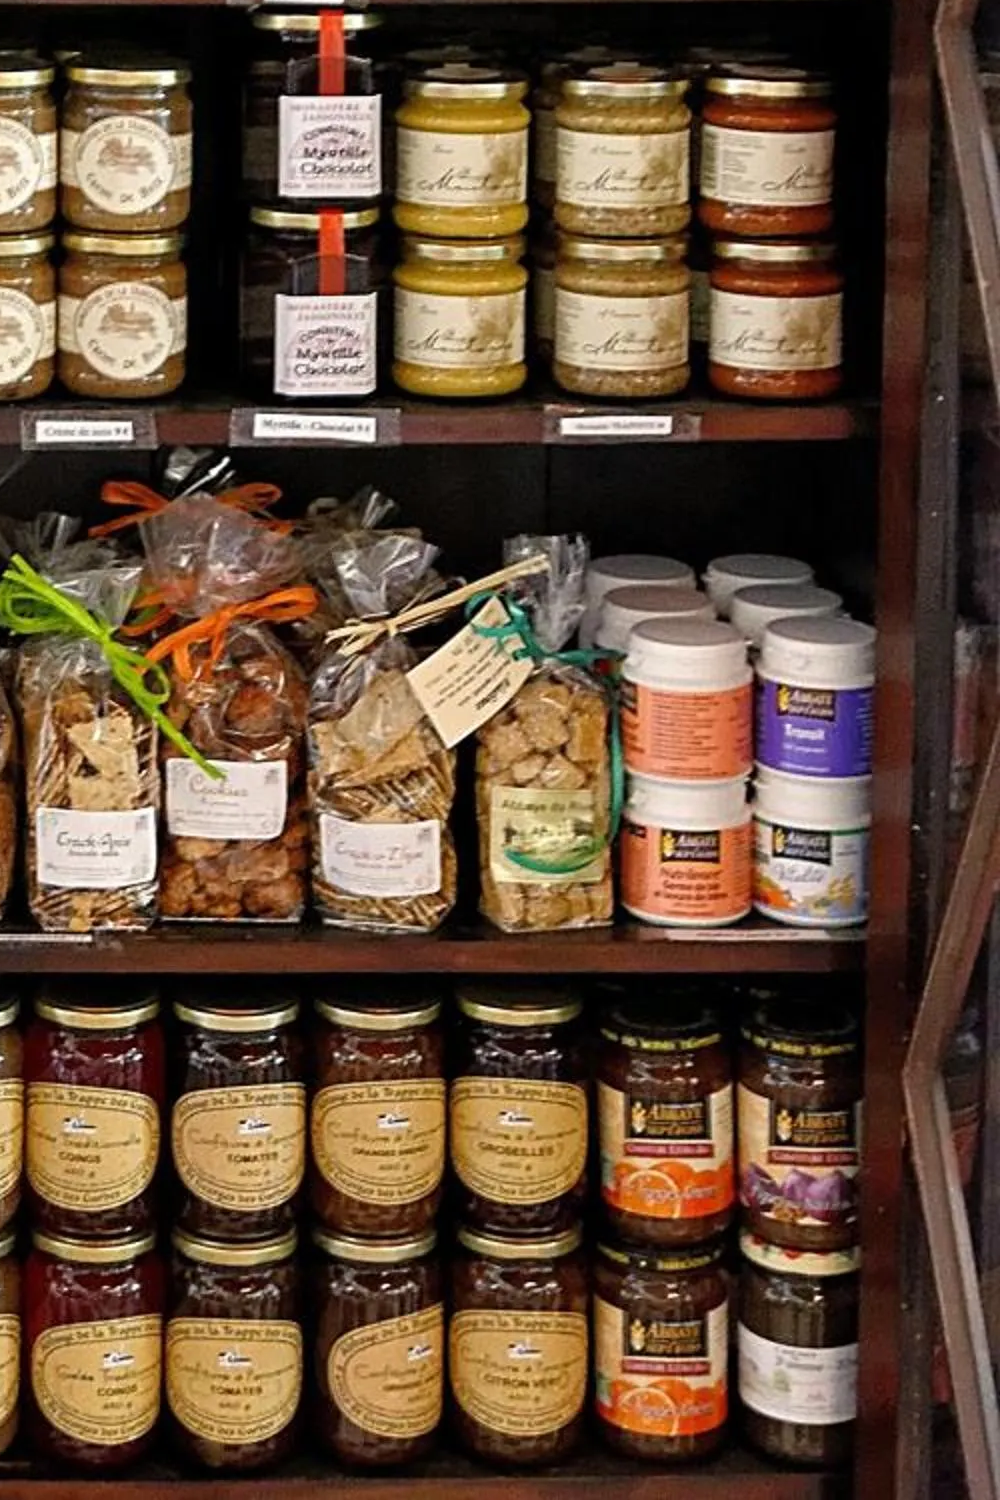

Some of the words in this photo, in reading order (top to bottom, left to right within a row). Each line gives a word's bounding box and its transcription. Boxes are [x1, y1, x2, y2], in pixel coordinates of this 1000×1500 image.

[295, 347, 362, 362] Myrtille
[294, 362, 366, 378] Chocolat
[477, 1141, 555, 1157] GROSEILLES
[57, 1151, 101, 1164] COINGS
[227, 1151, 278, 1164] TOMATES
[483, 1373, 529, 1388] CITRON
[96, 1383, 138, 1397] COINGS
[209, 1385, 263, 1396] TOMATES
